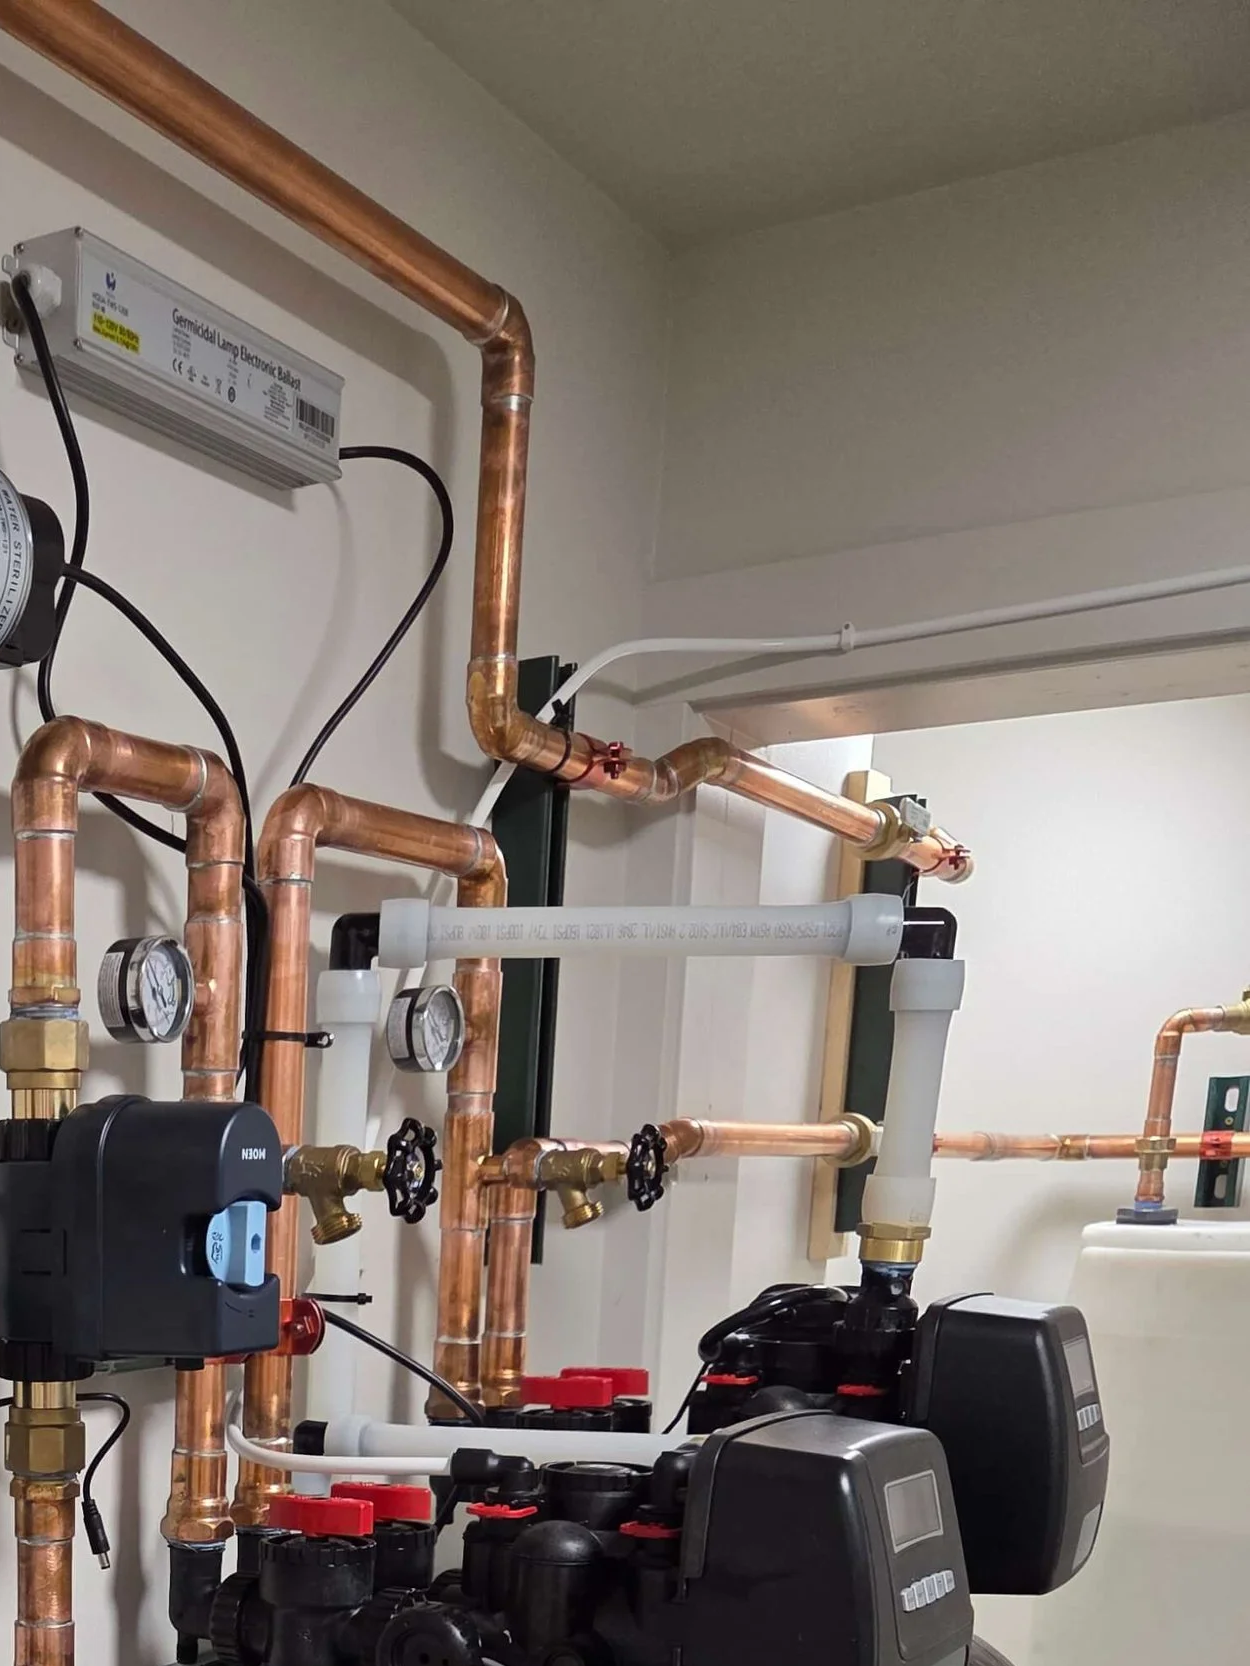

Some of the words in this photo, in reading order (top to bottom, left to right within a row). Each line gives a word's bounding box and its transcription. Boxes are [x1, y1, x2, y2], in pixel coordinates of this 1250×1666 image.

[172, 308, 216, 346] Germicidal
[217, 332, 239, 359] Lamp
[240, 344, 277, 379] Electronic
[277, 366, 301, 392] Ballast
[0, 487, 20, 534] WATER
[241, 1147, 266, 1161] MOEN
